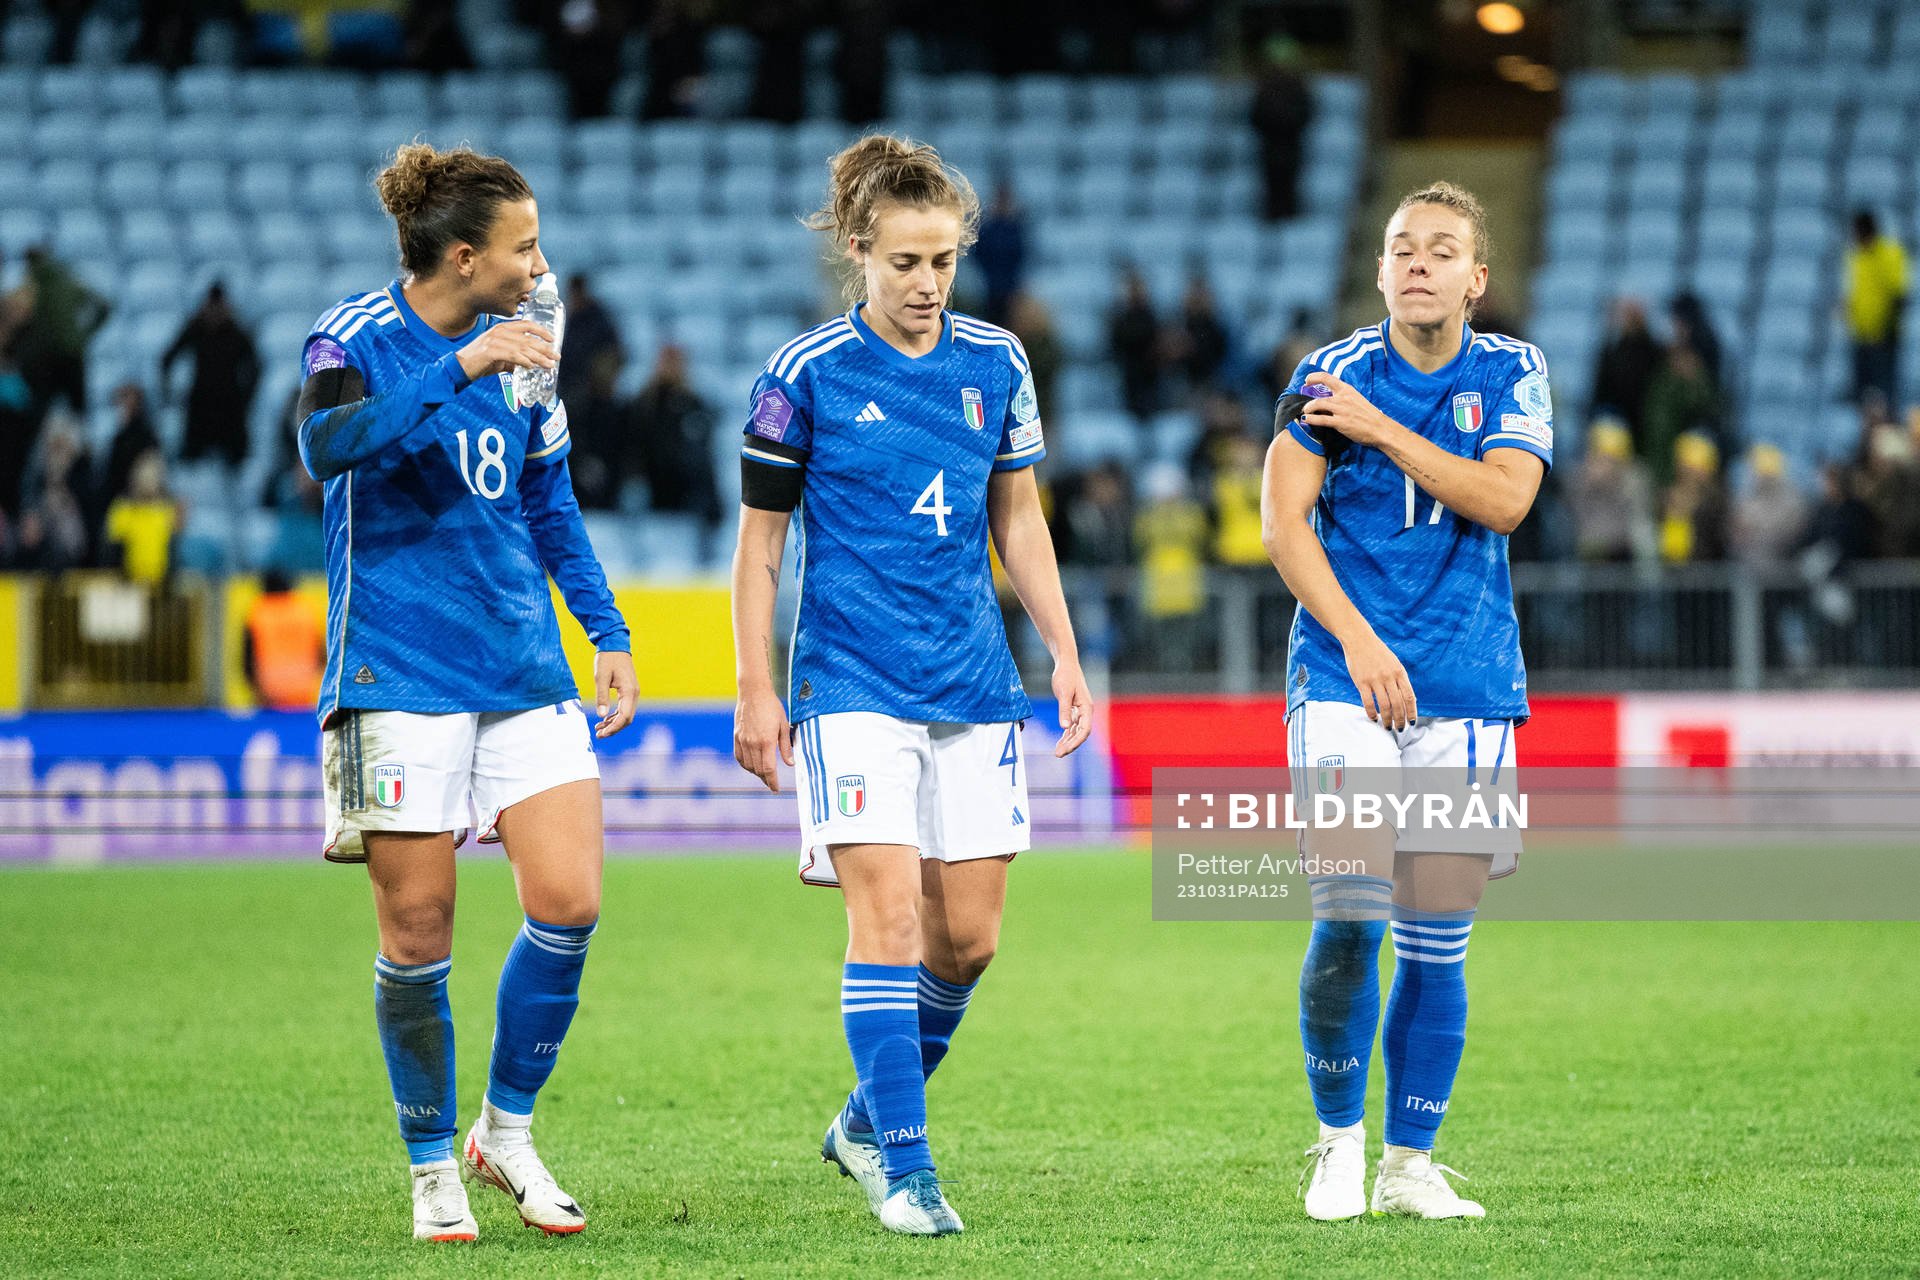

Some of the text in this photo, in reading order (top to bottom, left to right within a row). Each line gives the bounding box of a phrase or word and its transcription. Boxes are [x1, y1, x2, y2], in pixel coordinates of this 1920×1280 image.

[963, 390, 982, 401] ITALIA
[1454, 394, 1480, 406] ITALIA
[756, 421, 781, 434] NATIONS
[757, 427, 779, 439] LEAGUE
[455, 428, 507, 499] 18
[909, 469, 953, 536] 4
[998, 722, 1018, 786] 4
[1464, 719, 1510, 785] 17
[1319, 757, 1342, 769] ITALIA
[377, 768, 402, 777] ITALIA
[838, 778, 863, 788] ITALIA
[1305, 1051, 1359, 1073] ITALIA
[883, 1124, 928, 1143] ITALIA
